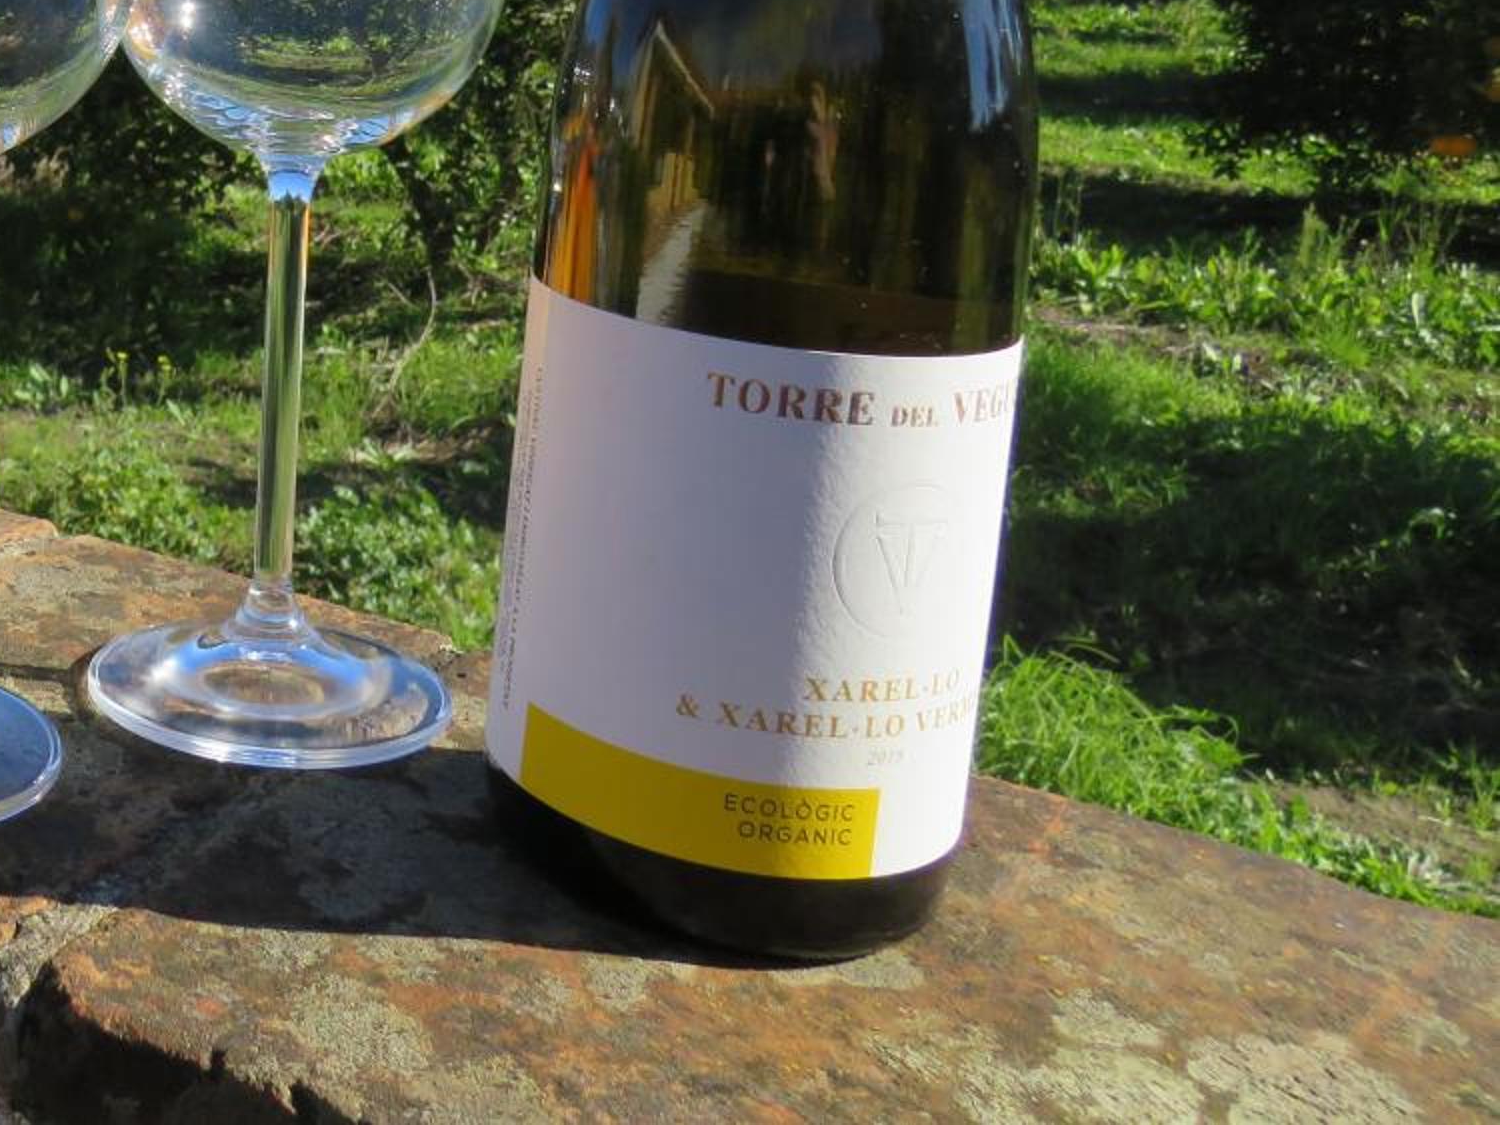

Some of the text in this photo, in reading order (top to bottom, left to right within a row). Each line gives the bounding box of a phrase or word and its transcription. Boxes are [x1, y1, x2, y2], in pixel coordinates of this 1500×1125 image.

[707, 372, 875, 427] TORRE
[891, 405, 939, 427] DEL
[676, 693, 700, 719] &
[738, 821, 853, 847] ORGANIC
